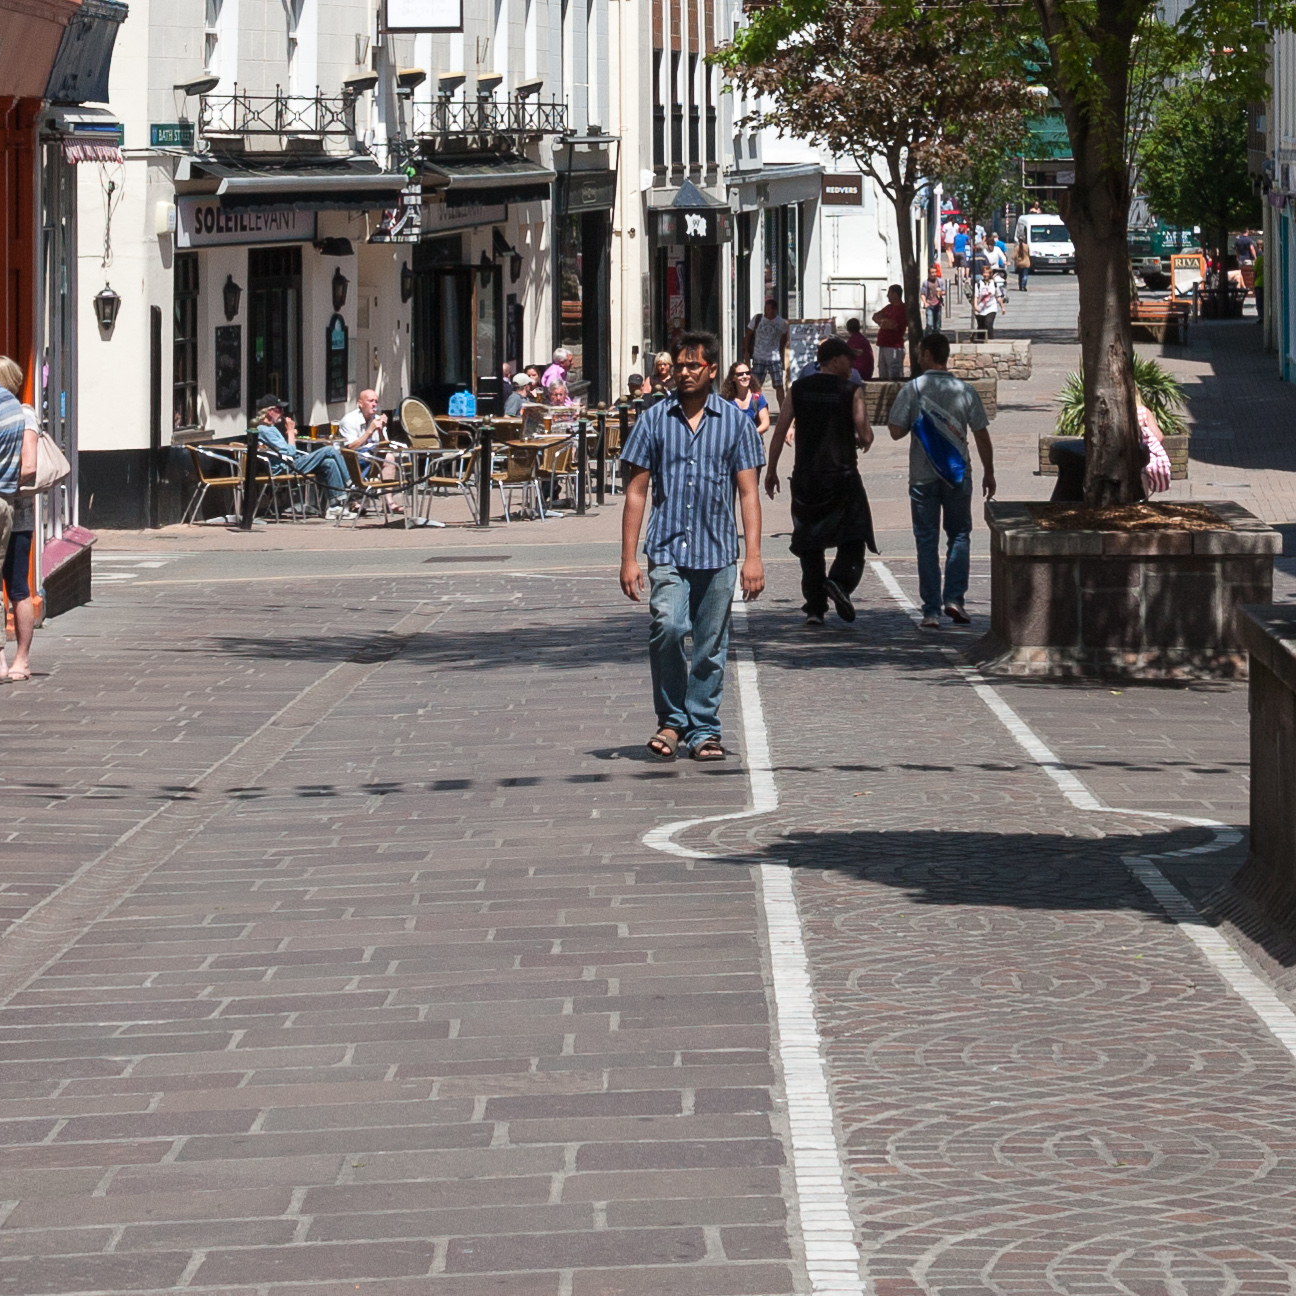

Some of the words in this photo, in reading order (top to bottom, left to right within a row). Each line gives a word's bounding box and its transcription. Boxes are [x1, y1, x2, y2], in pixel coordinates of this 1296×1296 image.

[158, 129, 173, 142] BATH
[173, 129, 194, 142] STREET
[825, 186, 858, 195] REDVERS
[1174, 258, 1200, 267] RIVA
